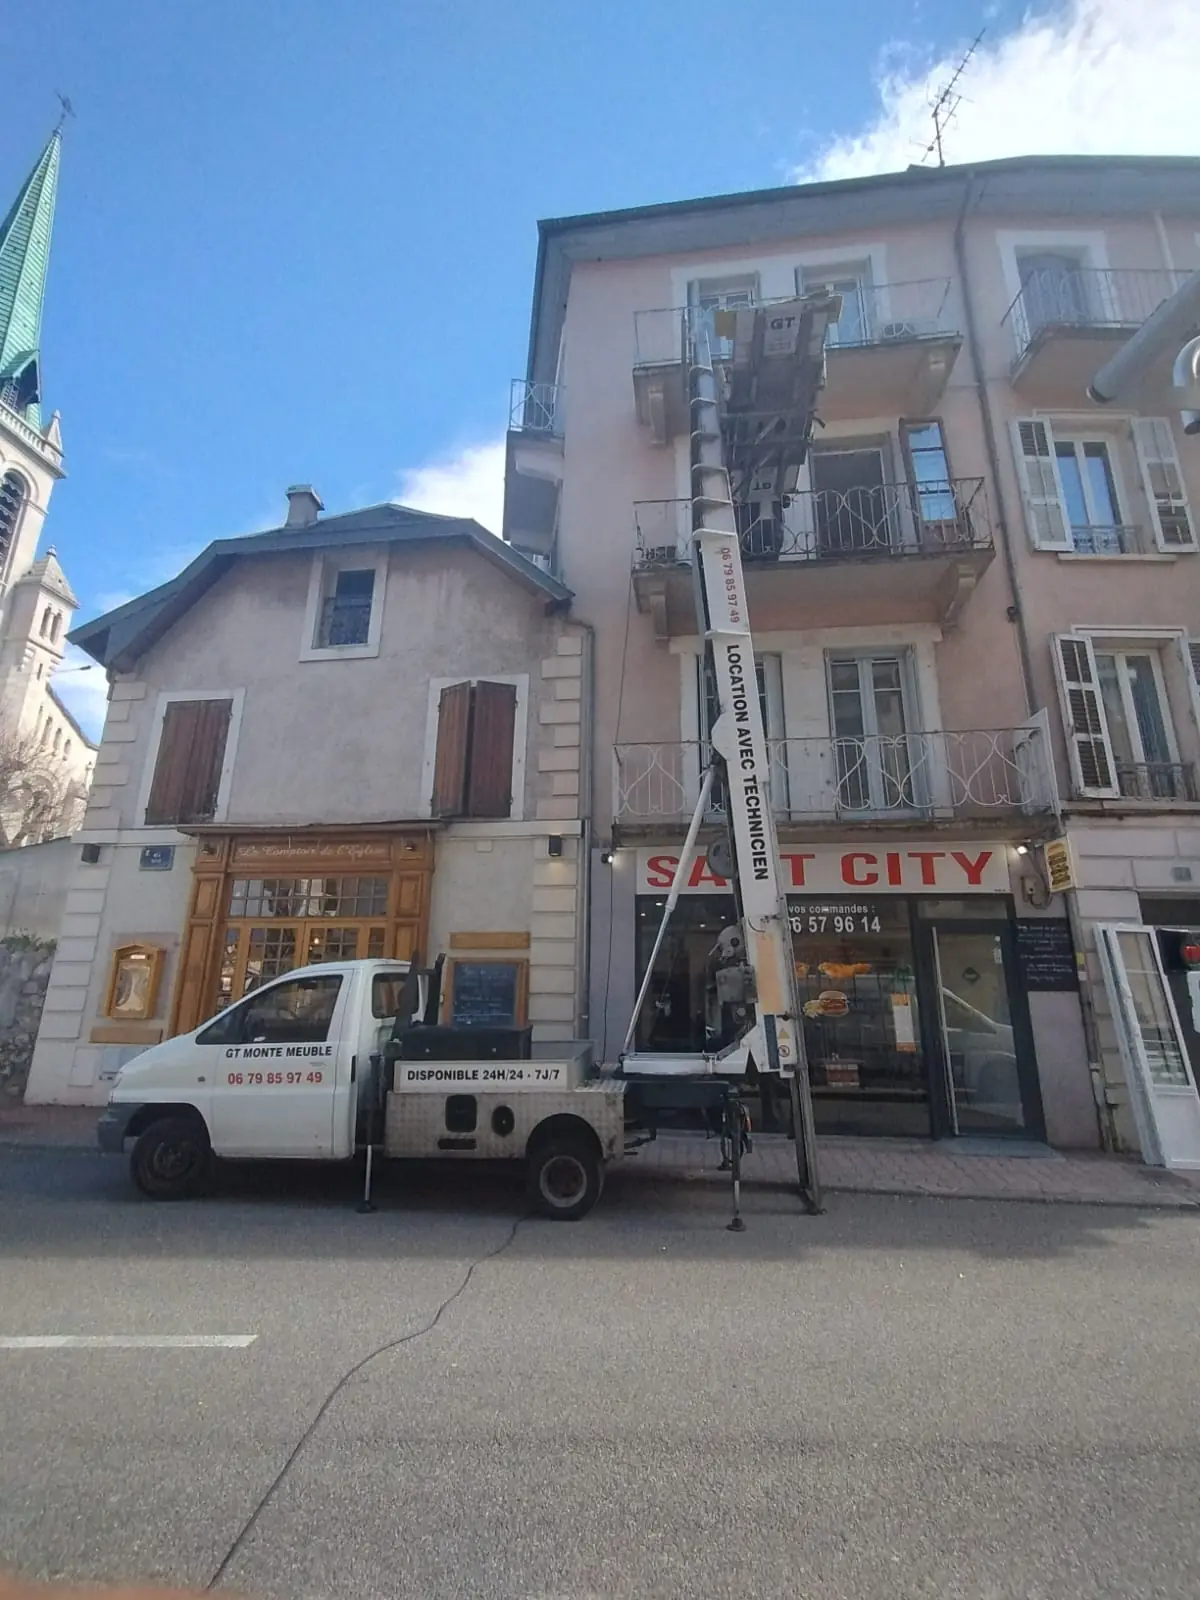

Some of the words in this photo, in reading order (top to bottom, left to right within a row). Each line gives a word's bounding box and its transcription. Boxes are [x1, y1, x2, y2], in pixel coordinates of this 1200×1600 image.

[771, 316, 796, 330] GT
[721, 547, 732, 561] 06
[723, 562, 734, 575] 79
[725, 578, 736, 592] 85
[727, 594, 738, 607] 97
[730, 610, 740, 623] 49
[727, 644, 749, 723] LOCATION
[737, 727, 755, 770] AVEC
[743, 774, 769, 881] TECHNICIEN
[646, 853, 816, 888] SAT
[840, 851, 993, 887] CITY
[788, 905, 806, 914] vos
[788, 915, 802, 933] 6
[808, 916, 828, 933] 57
[834, 916, 855, 933] 96
[861, 916, 881, 933] 14
[225, 1048, 240, 1058] GT
[243, 1047, 283, 1058] MONTE
[286, 1046, 332, 1057] MEUBLE
[227, 1073, 243, 1085] 06
[247, 1072, 263, 1084] 79
[267, 1072, 283, 1084] 85
[286, 1072, 302, 1084] 97
[306, 1071, 323, 1083] 49
[407, 1070, 479, 1081] DISPONIBLE
[482, 1069, 523, 1081] 24H/24
[535, 1069, 560, 1081] 7J/7
